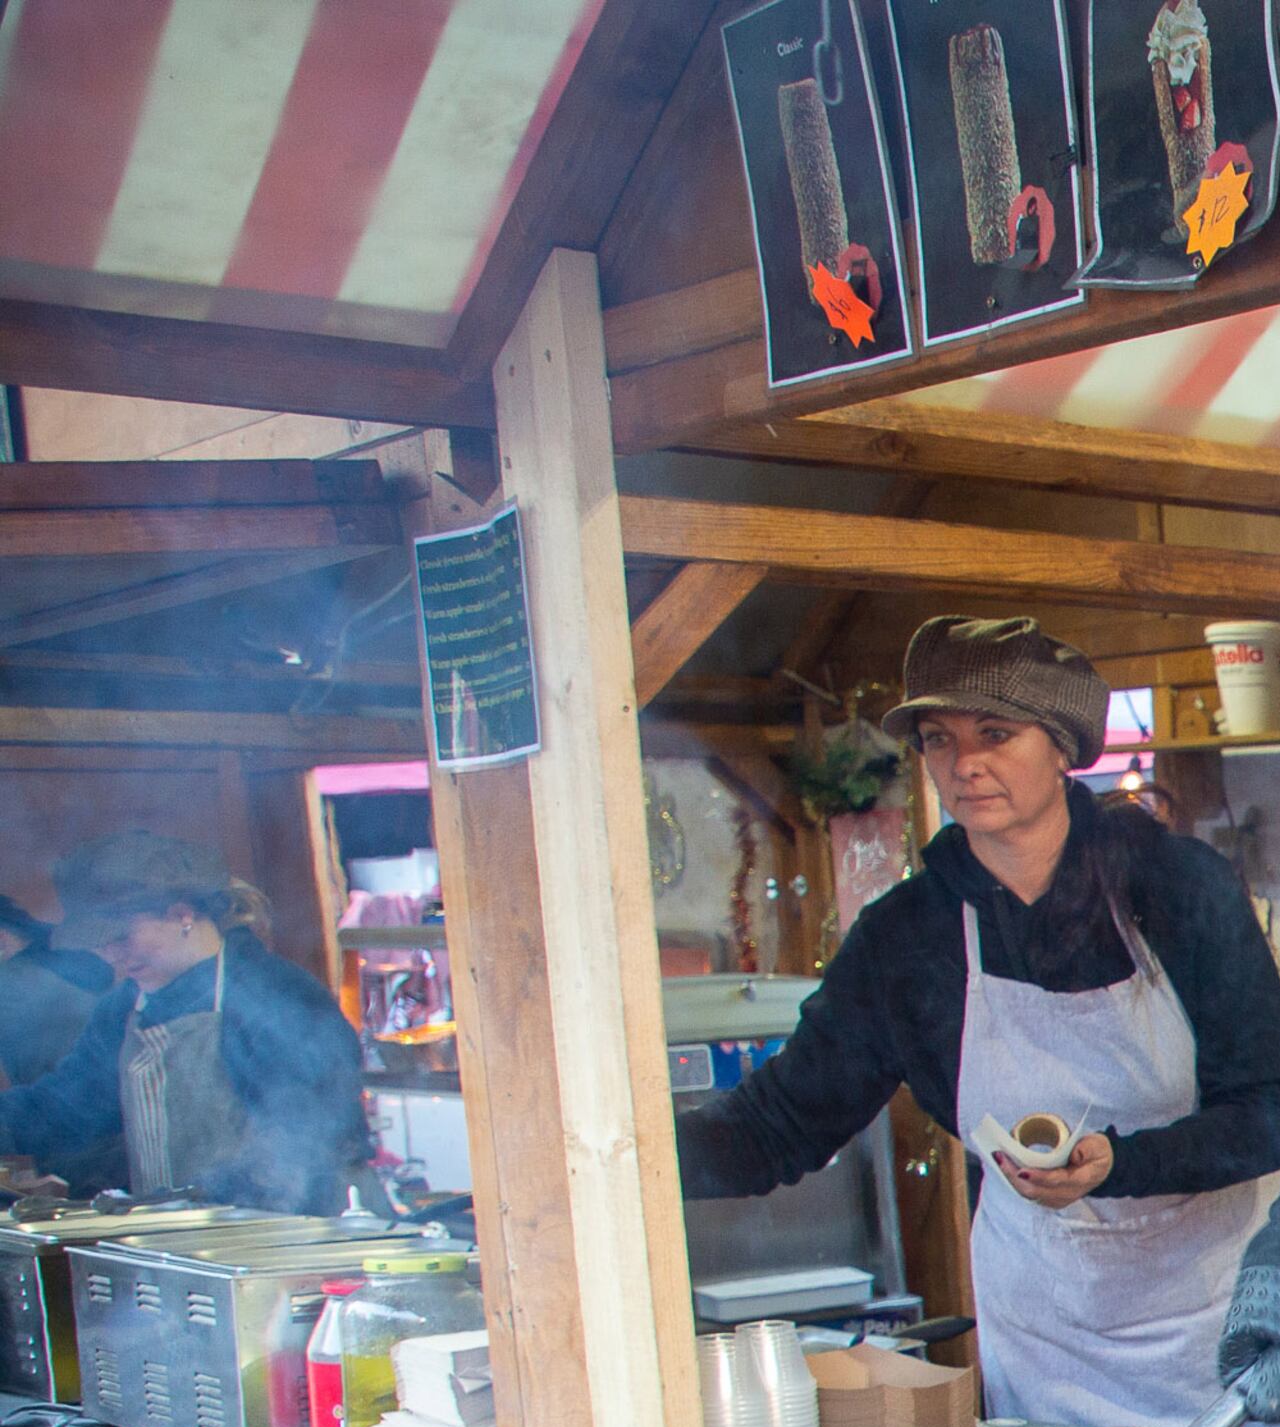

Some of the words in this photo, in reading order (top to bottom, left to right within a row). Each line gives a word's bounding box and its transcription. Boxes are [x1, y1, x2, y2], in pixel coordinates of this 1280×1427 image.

[777, 37, 803, 57] Classic
[1198, 195, 1230, 235] $12
[827, 288, 851, 320] $6
